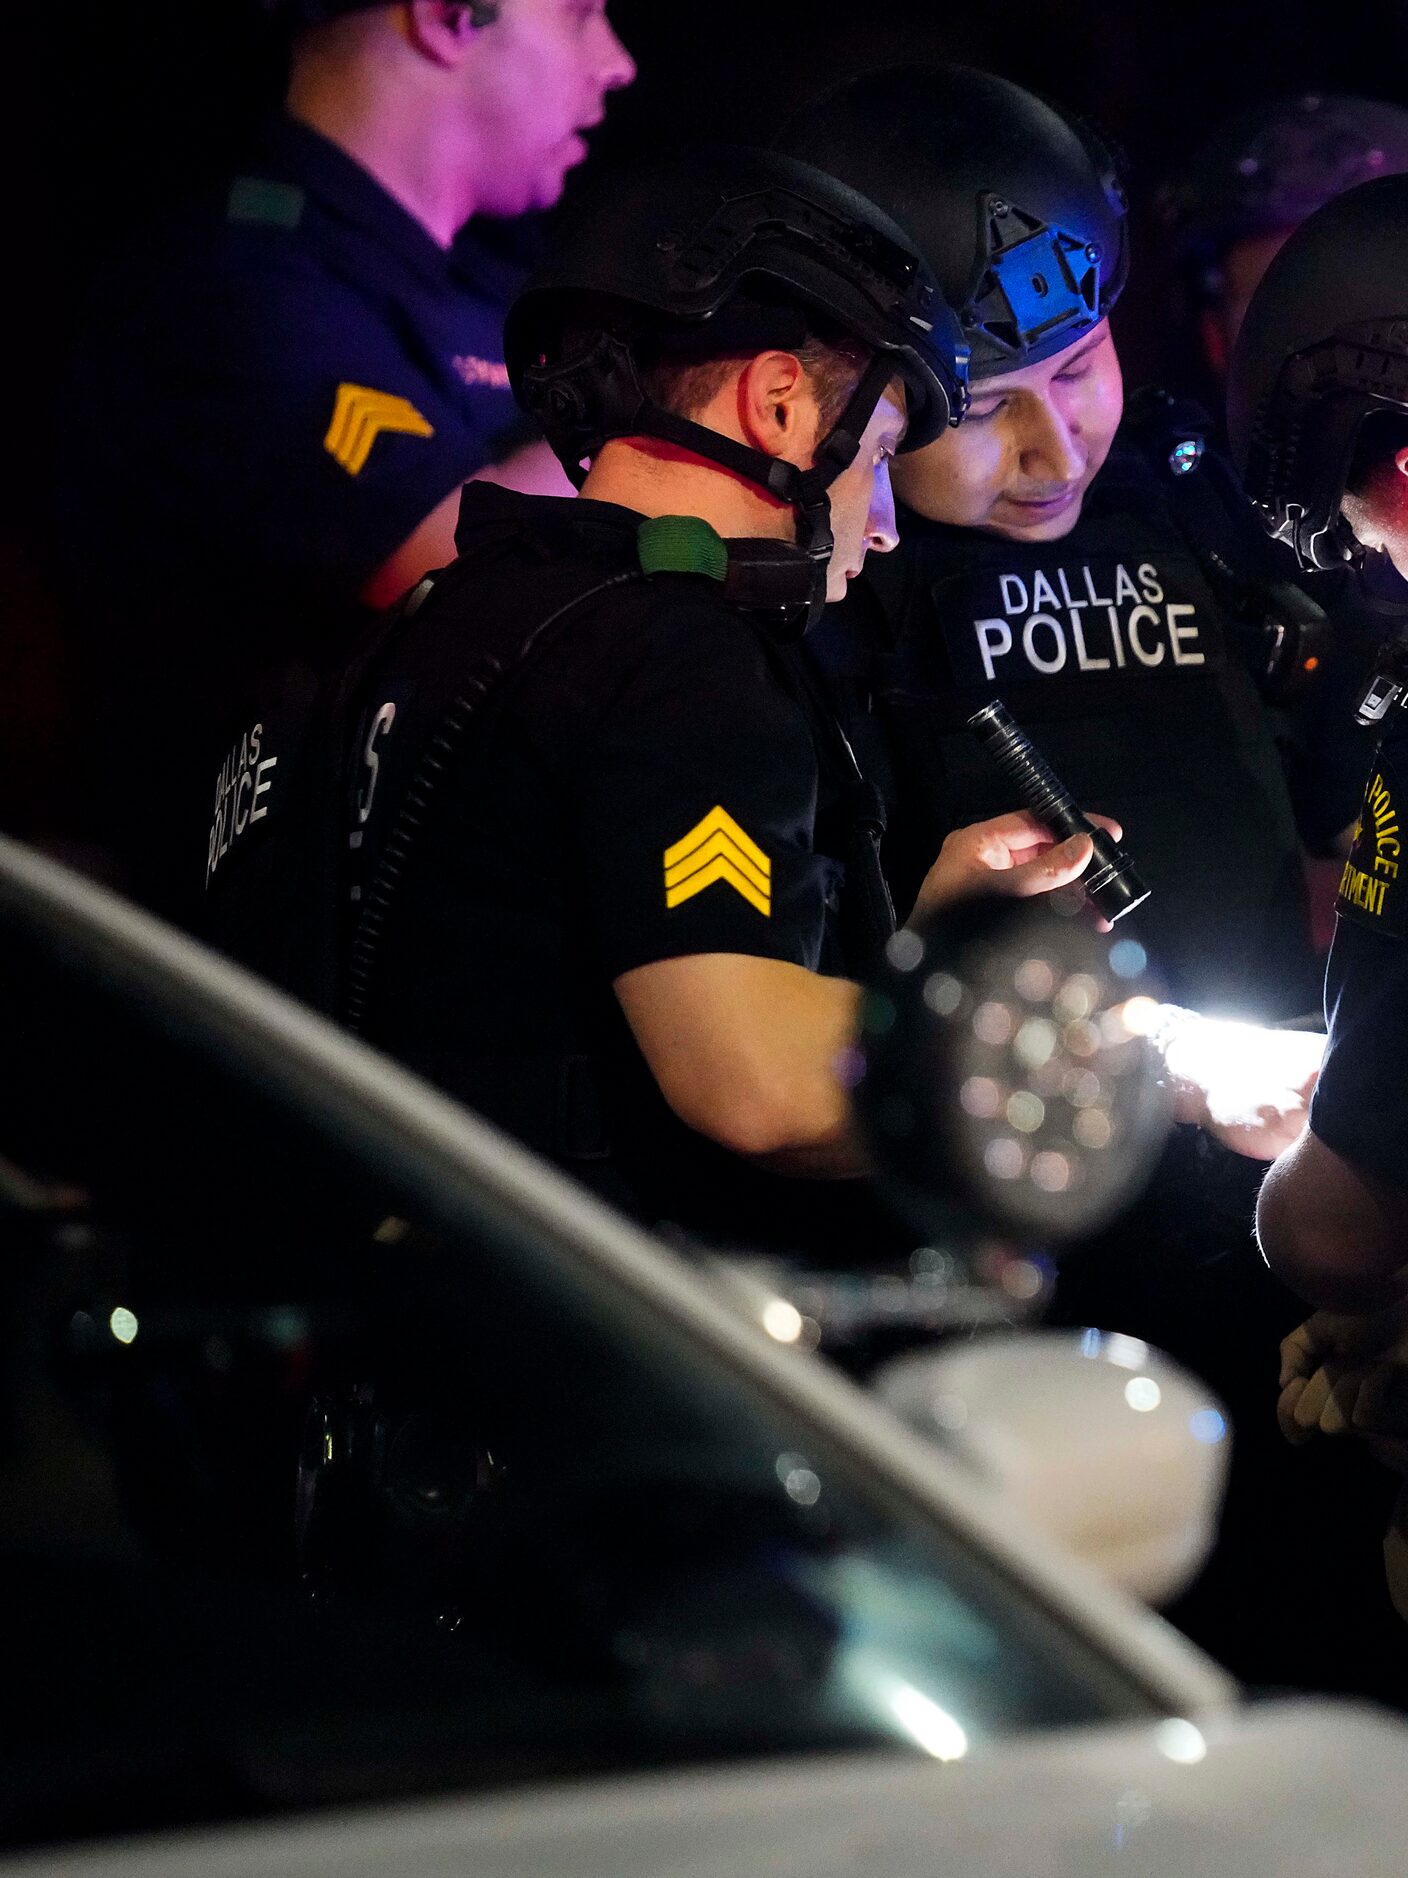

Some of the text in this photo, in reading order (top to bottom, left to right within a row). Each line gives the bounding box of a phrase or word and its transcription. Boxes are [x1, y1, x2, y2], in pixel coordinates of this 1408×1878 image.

[999, 563, 1164, 615] DALLAS
[973, 603, 1205, 681] POLICE
[205, 756, 278, 891] POLICE
[1367, 773, 1400, 879] POLICE
